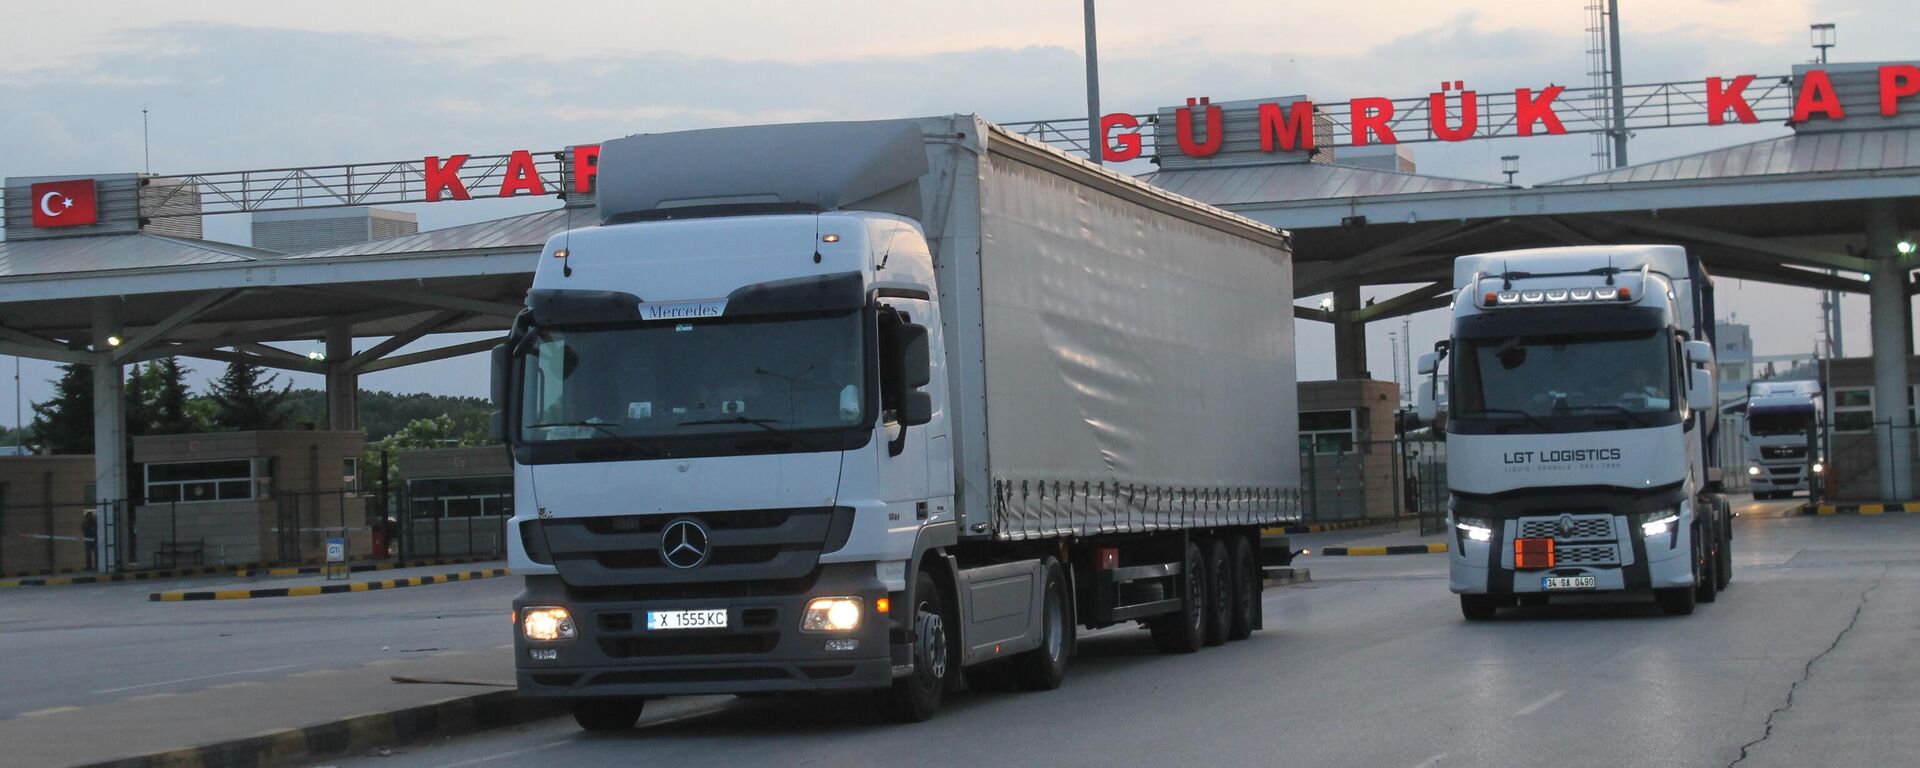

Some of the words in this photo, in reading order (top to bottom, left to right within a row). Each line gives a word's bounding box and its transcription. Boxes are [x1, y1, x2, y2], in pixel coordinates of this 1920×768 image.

[1100, 80, 1568, 162] GÜMRÜK
[1706, 64, 1920, 126] KAP
[649, 304, 718, 319] Mercedes
[1504, 451, 1534, 464] LGT
[1540, 448, 1621, 463] LOGISTICS
[1547, 579, 1557, 588] 34
[1561, 579, 1571, 587] SA
[660, 613, 668, 627] X
[676, 612, 705, 626] 1555
[707, 611, 724, 626] KC
